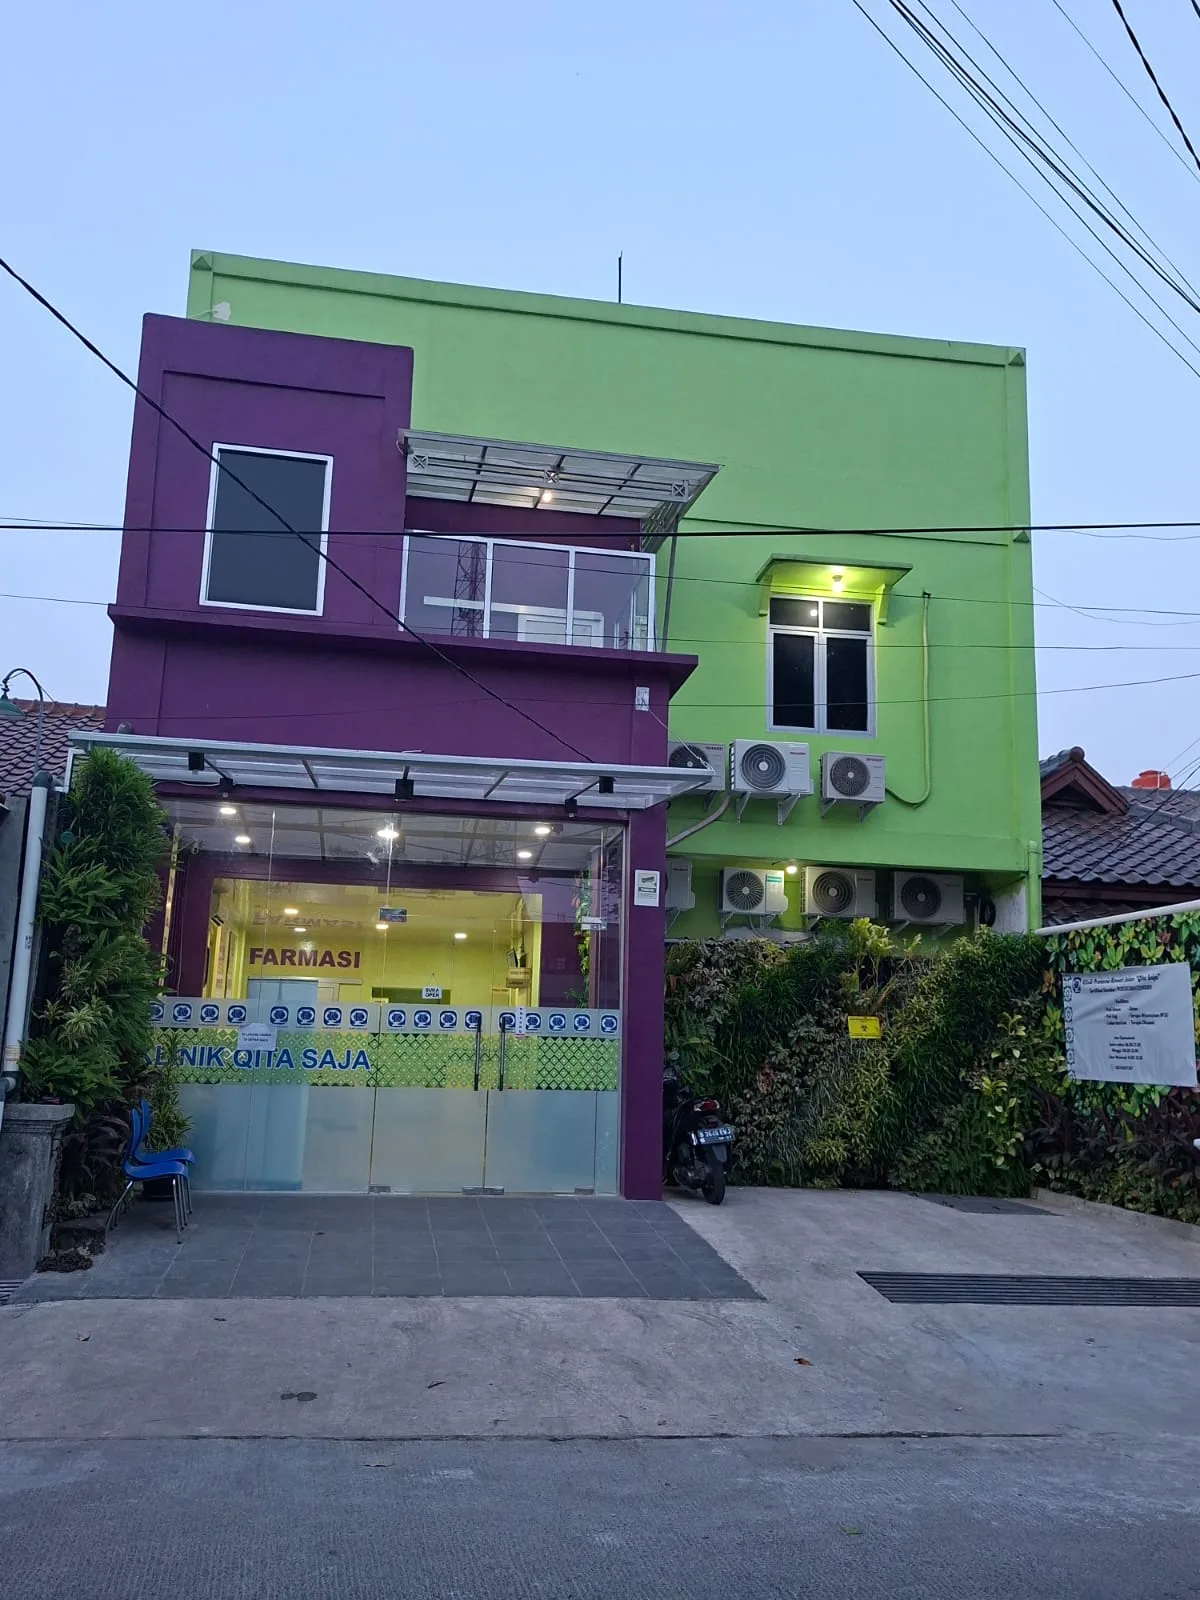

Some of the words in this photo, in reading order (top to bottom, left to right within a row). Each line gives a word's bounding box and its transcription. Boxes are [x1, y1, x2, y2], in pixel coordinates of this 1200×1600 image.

[250, 948, 360, 968] FARMASI
[233, 1049, 294, 1068] QITA
[302, 1049, 371, 1070] SAJA
